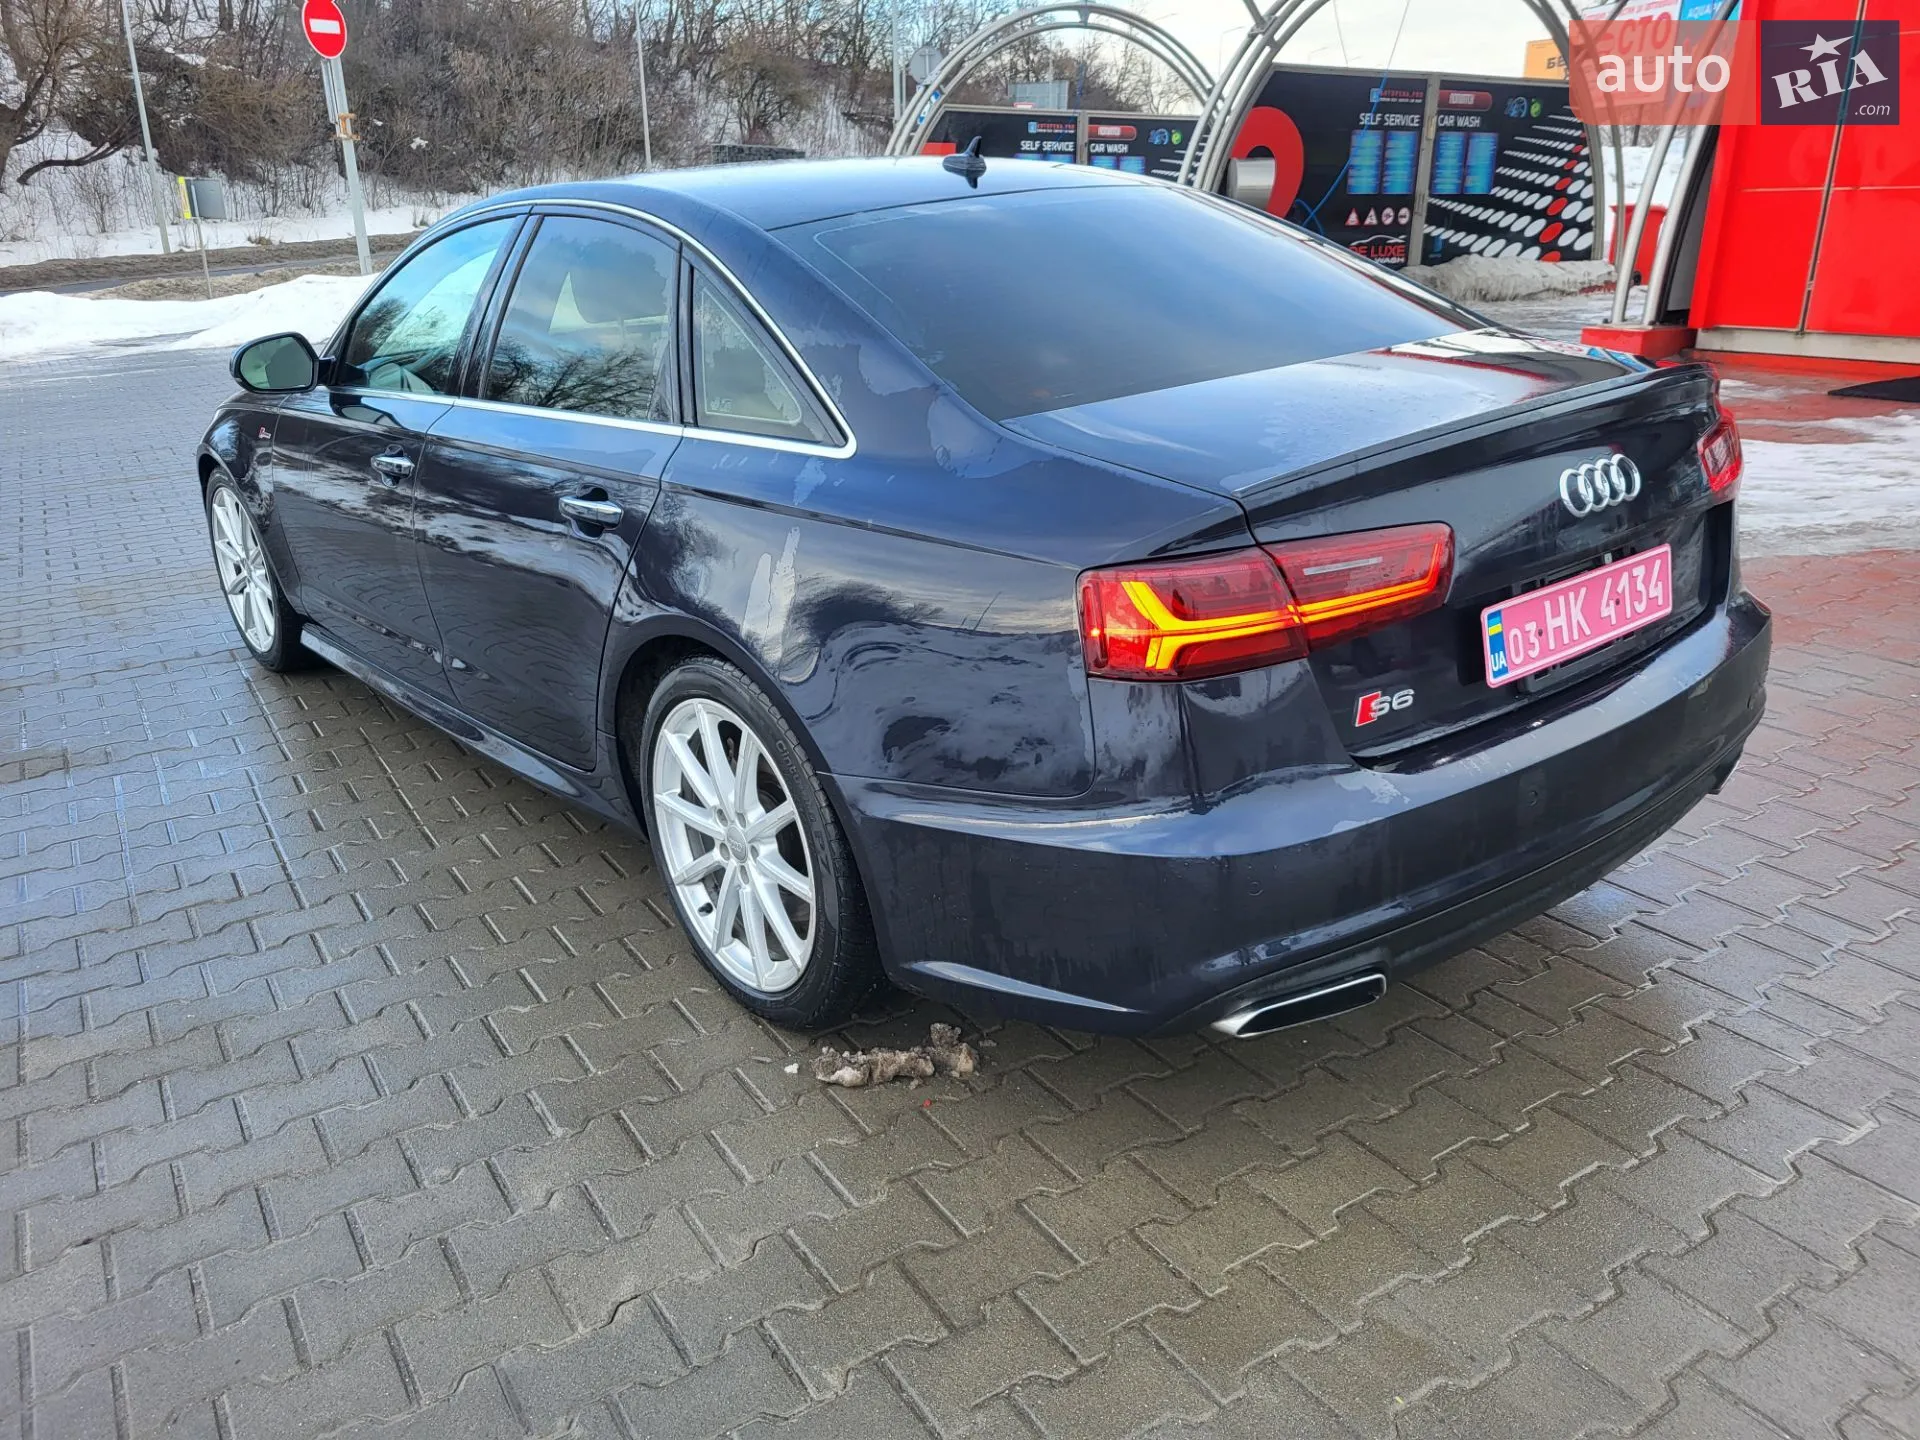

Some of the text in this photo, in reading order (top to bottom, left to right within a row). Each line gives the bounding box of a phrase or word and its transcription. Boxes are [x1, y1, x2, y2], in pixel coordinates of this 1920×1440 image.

[1359, 112, 1481, 128] SELF SERVICE CAR WASH
[1020, 140, 1129, 153] SELF SERVICE CAR WASH
[1370, 244, 1406, 258] LUXE
[1490, 559, 1664, 672] UA 03 HK 4134
[1368, 688, 1415, 719] S6
